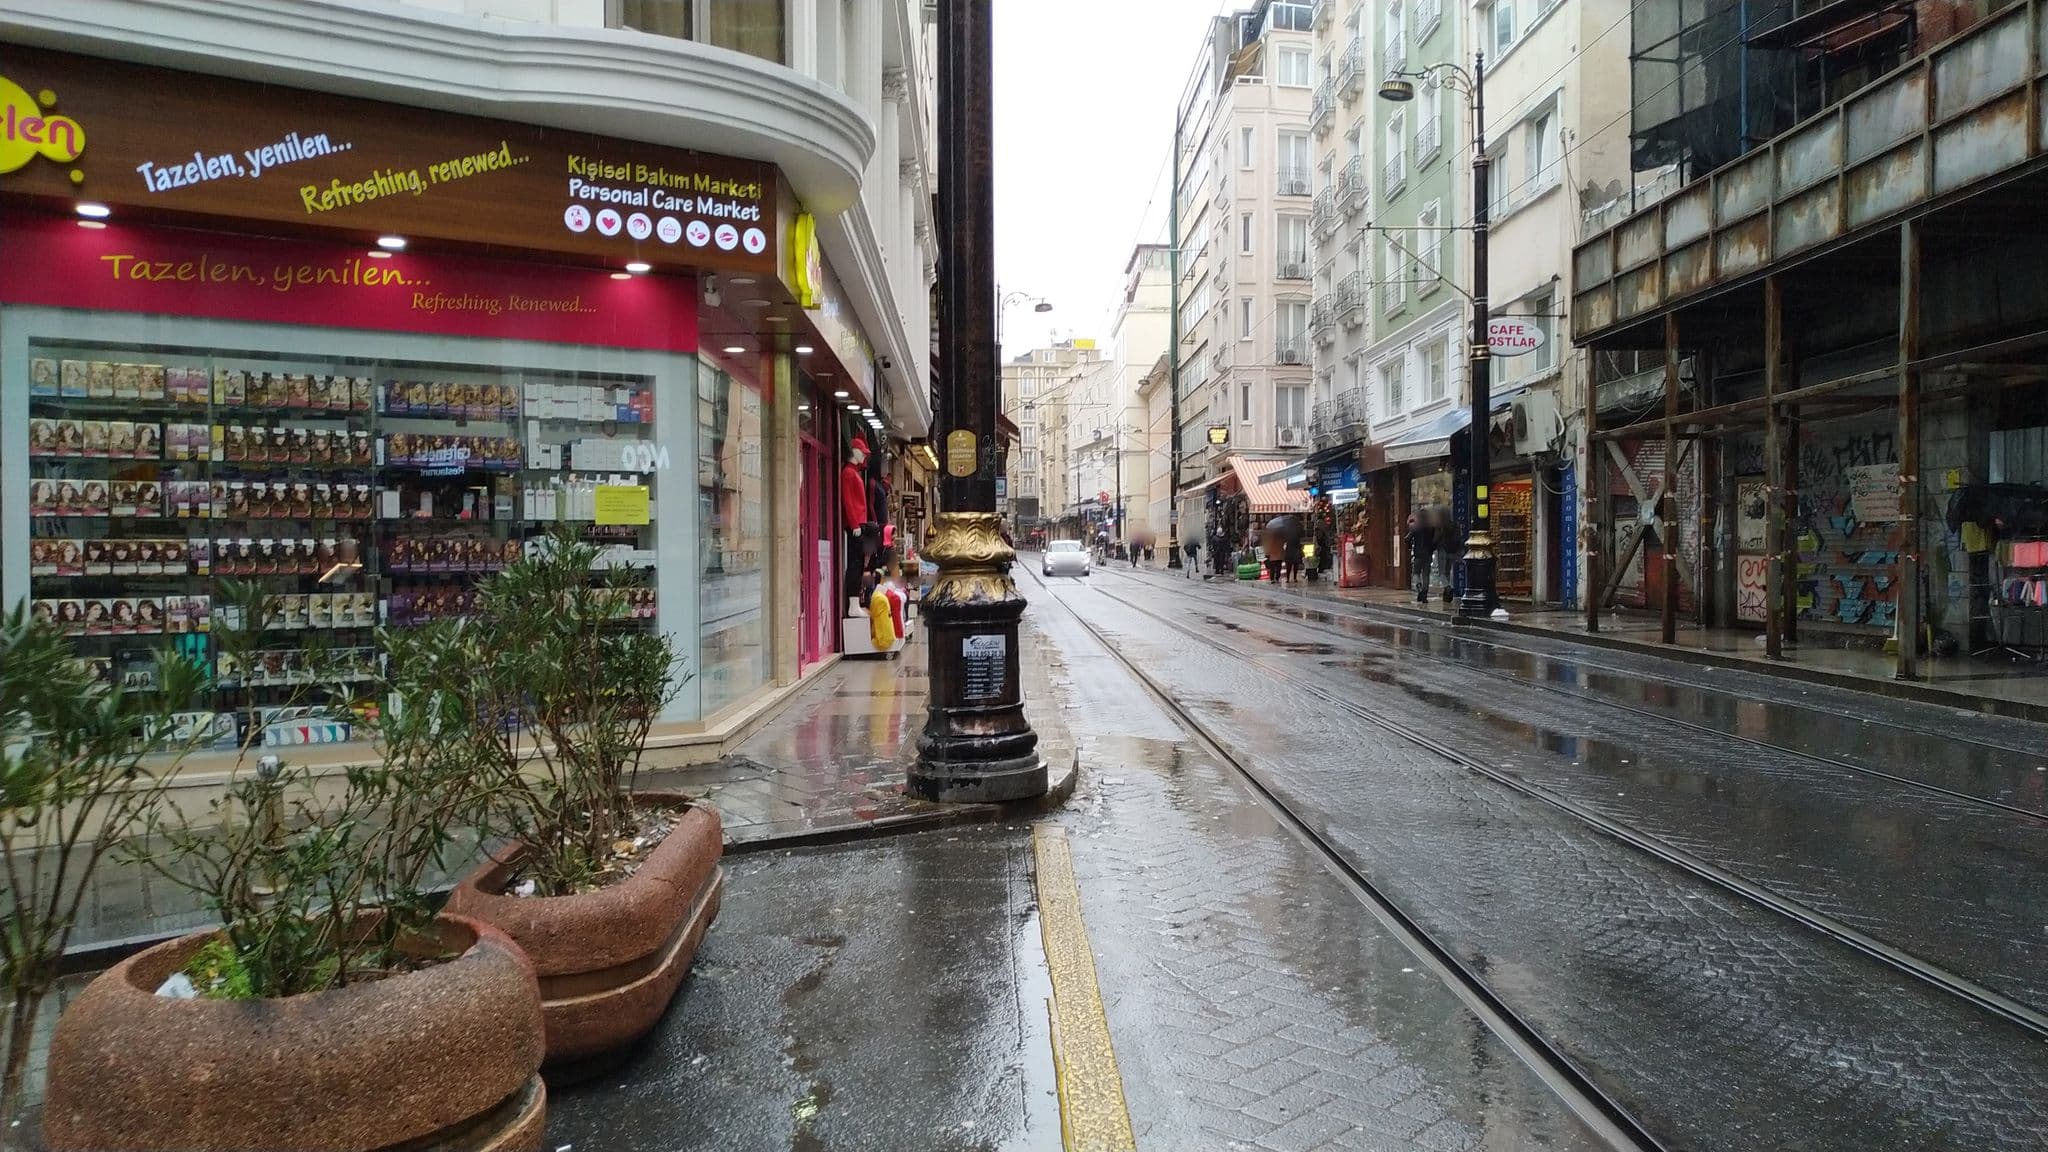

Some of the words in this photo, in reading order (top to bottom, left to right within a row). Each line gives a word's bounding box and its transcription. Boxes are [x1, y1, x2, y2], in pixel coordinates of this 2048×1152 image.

[0, 103, 80, 160] len
[136, 151, 245, 193] Tazelen,
[244, 131, 353, 178] yenilen...
[300, 168, 428, 215] Refreshing,
[428, 140, 530, 184] renewed...
[567, 154, 631, 182] Kişisel
[635, 164, 690, 190] Bakım
[693, 172, 762, 200] Marketi
[568, 178, 649, 207] Personal
[652, 189, 693, 213] Care
[697, 196, 761, 222] Market
[100, 254, 265, 286] Tazelen,
[272, 258, 431, 292] yenilen...
[411, 293, 502, 316] Refreshing,
[1487, 336, 1537, 347] OSTLAR
[1489, 324, 1525, 335] CAFE
[1564, 474, 1573, 543] conomic
